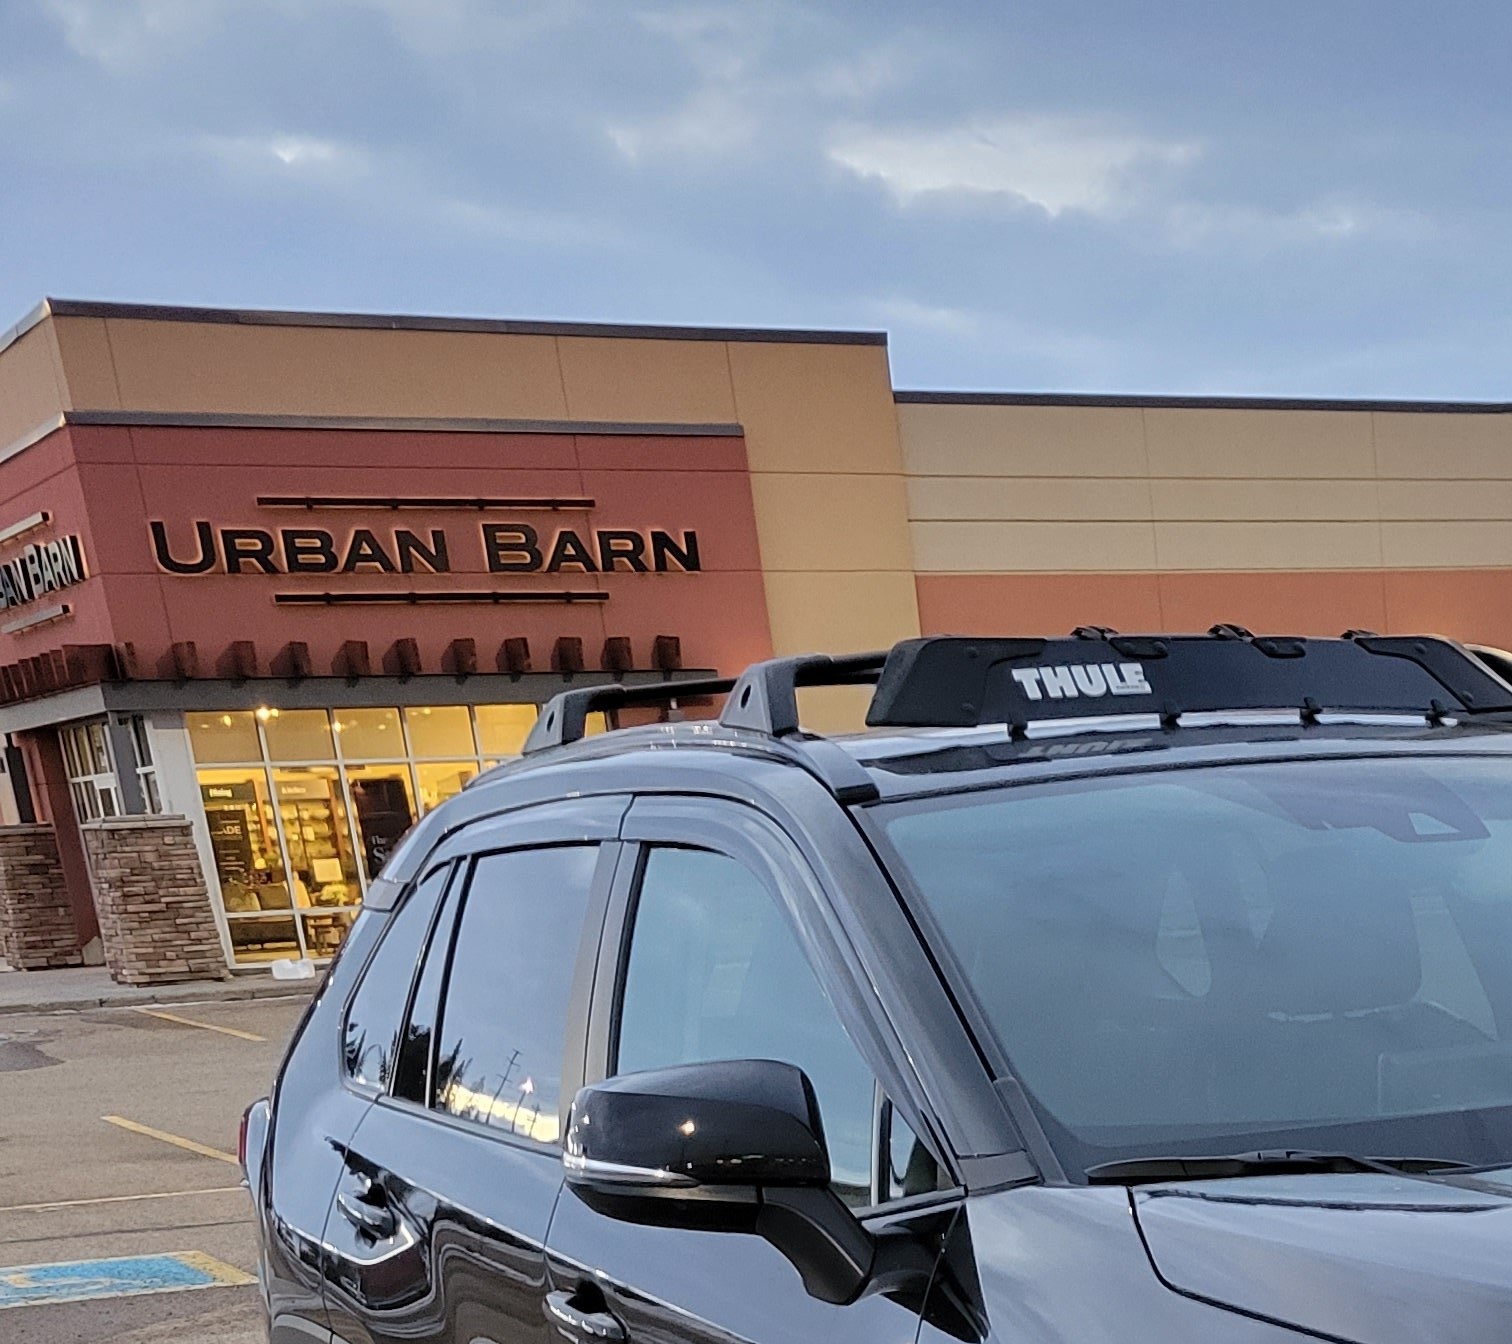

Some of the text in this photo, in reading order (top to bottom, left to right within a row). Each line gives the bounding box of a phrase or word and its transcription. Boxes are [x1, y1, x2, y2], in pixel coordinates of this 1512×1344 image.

[23, 534, 86, 599] BARN
[150, 521, 700, 574] URBAN BARN
[1011, 661, 1152, 700] THULE
